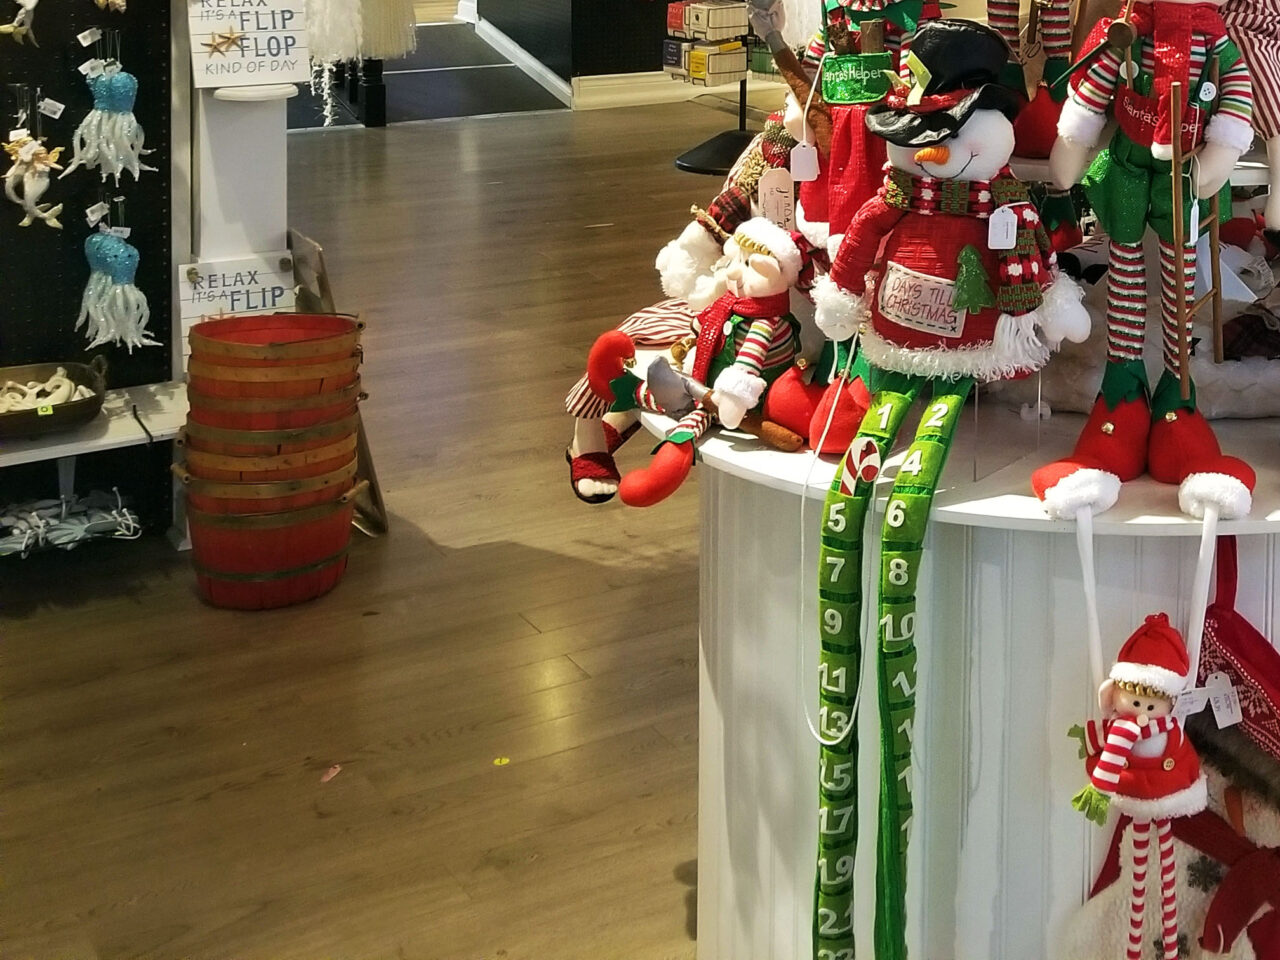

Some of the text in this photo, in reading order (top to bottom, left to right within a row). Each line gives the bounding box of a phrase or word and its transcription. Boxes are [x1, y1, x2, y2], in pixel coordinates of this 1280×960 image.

[200, 9, 294, 31] IT'S A FLIP
[240, 36, 296, 58] FLOP
[206, 60, 298, 75] KIND OF DAY
[849, 64, 881, 85] Helper
[193, 270, 259, 290] RELAX
[892, 277, 954, 307] DAYS TILL
[192, 286, 284, 311] IT'S A FLIP
[877, 403, 894, 430] 1
[925, 403, 949, 428] 2
[900, 450, 922, 476] 4
[827, 502, 847, 533] 5
[887, 500, 906, 528] 6
[826, 557, 846, 583] 7
[889, 558, 909, 585] 8
[824, 608, 842, 635] 9
[879, 612, 916, 641] 10
[818, 662, 847, 693] 11
[892, 663, 917, 698] 1
[819, 706, 849, 739] 13
[820, 758, 851, 791] 15
[818, 806, 853, 835] 17
[818, 855, 853, 885] 19
